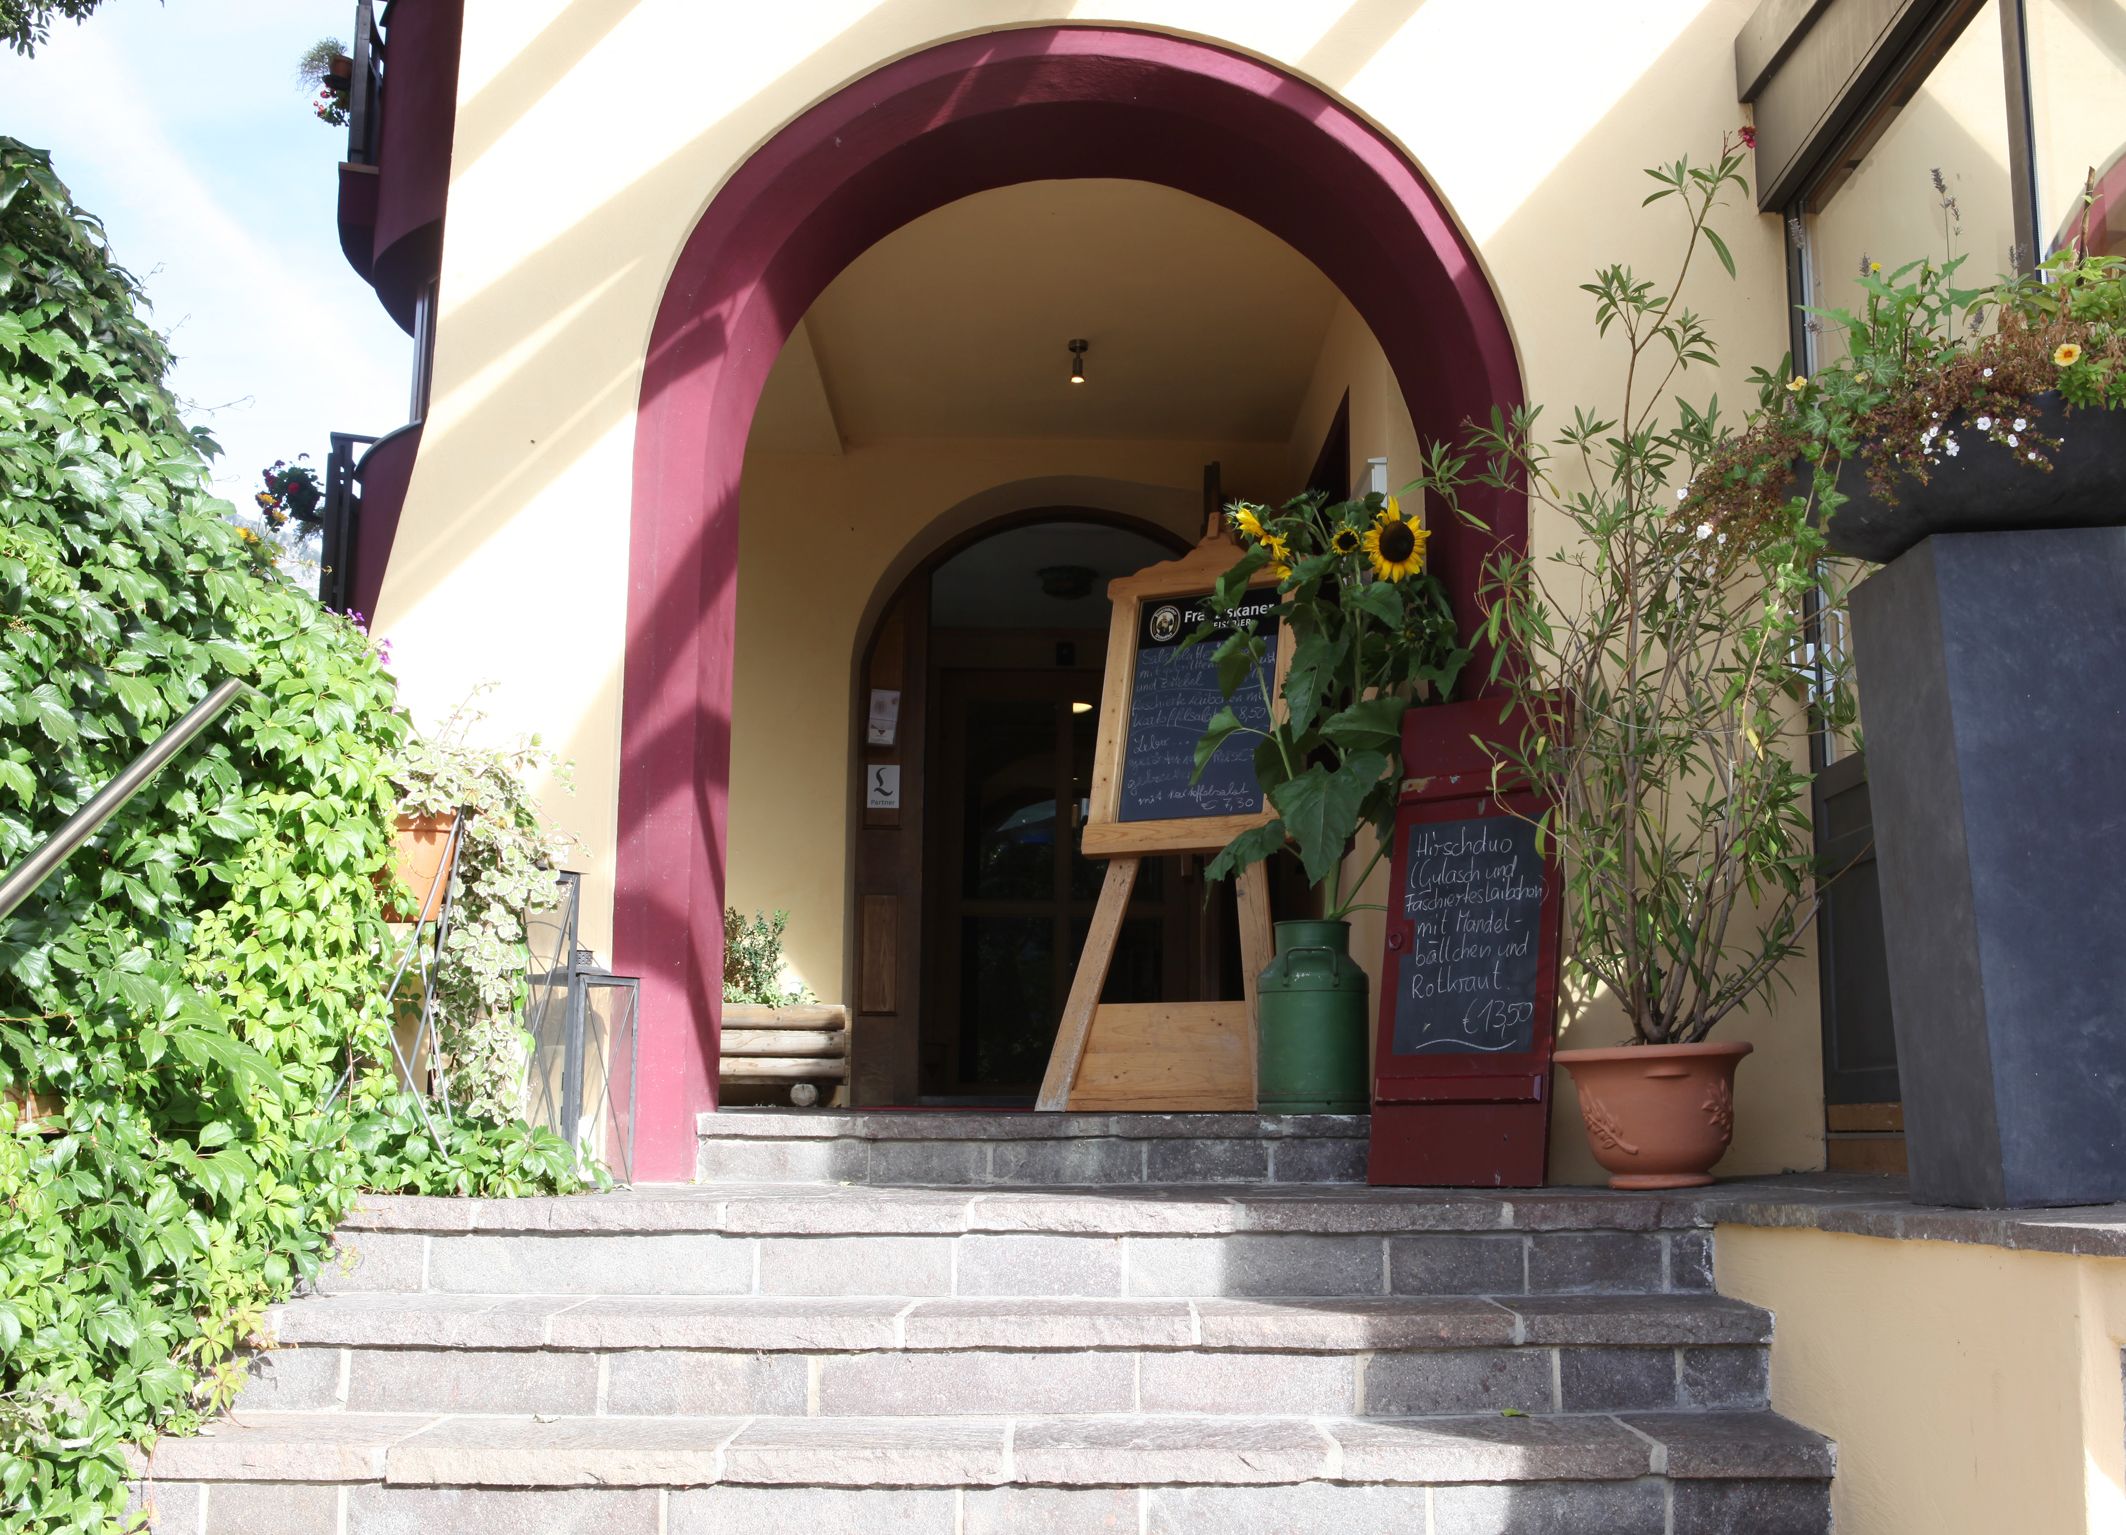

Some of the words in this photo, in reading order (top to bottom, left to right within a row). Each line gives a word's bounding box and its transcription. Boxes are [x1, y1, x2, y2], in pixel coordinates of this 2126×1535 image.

[1184, 603, 1275, 623] Fraskaner
[1238, 705, 1266, 723] 8,50
[870, 799, 896, 807] Partner
[1222, 798, 1254, 812] 7,30
[1415, 825, 1513, 857] Hirschduo
[1485, 854, 1518, 879] und
[1416, 909, 1448, 938] mit
[1497, 930, 1530, 957] und
